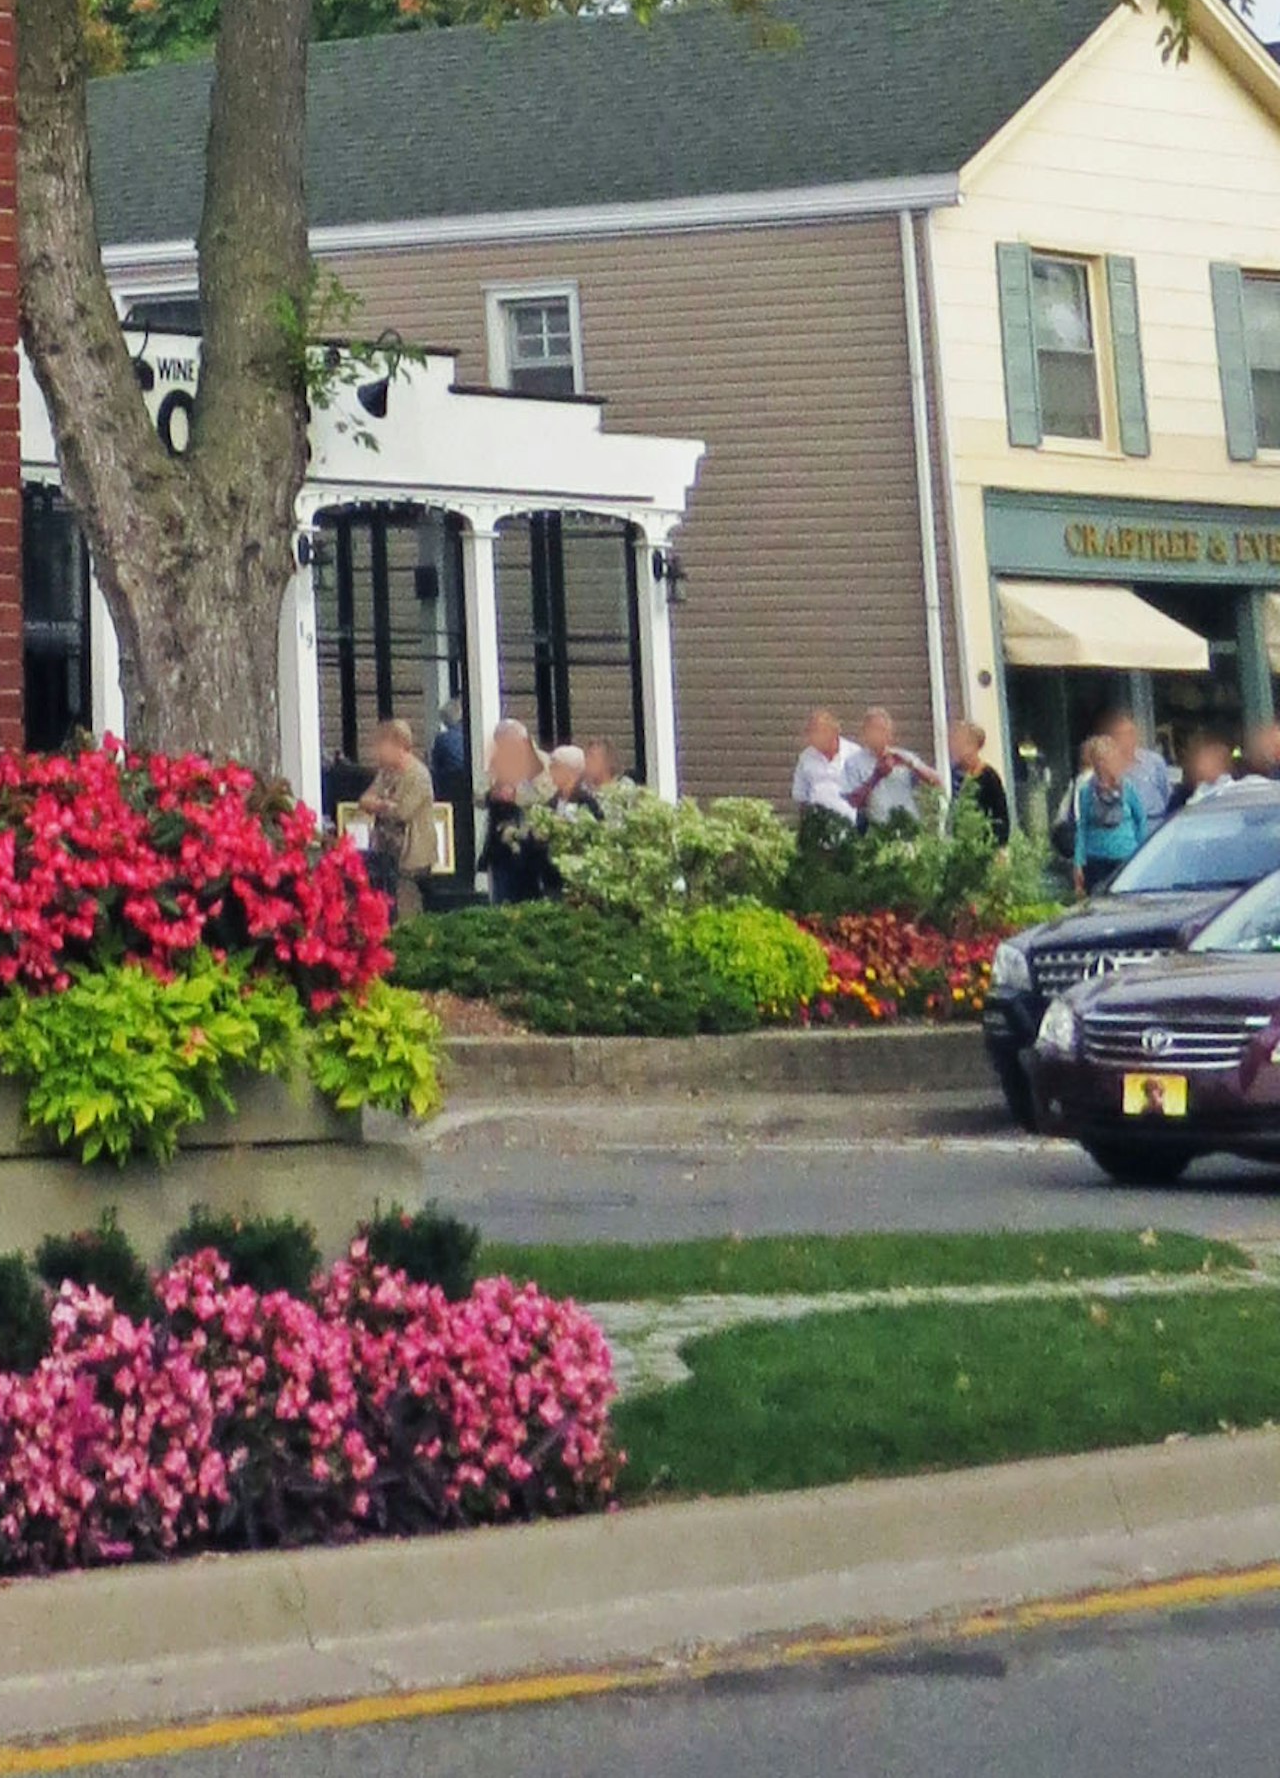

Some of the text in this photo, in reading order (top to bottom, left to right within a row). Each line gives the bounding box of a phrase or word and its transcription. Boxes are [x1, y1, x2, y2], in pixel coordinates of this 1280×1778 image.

[156, 357, 195, 382] WINE
[1065, 523, 1200, 563] CRABTREE
[1207, 530, 1228, 565] &
